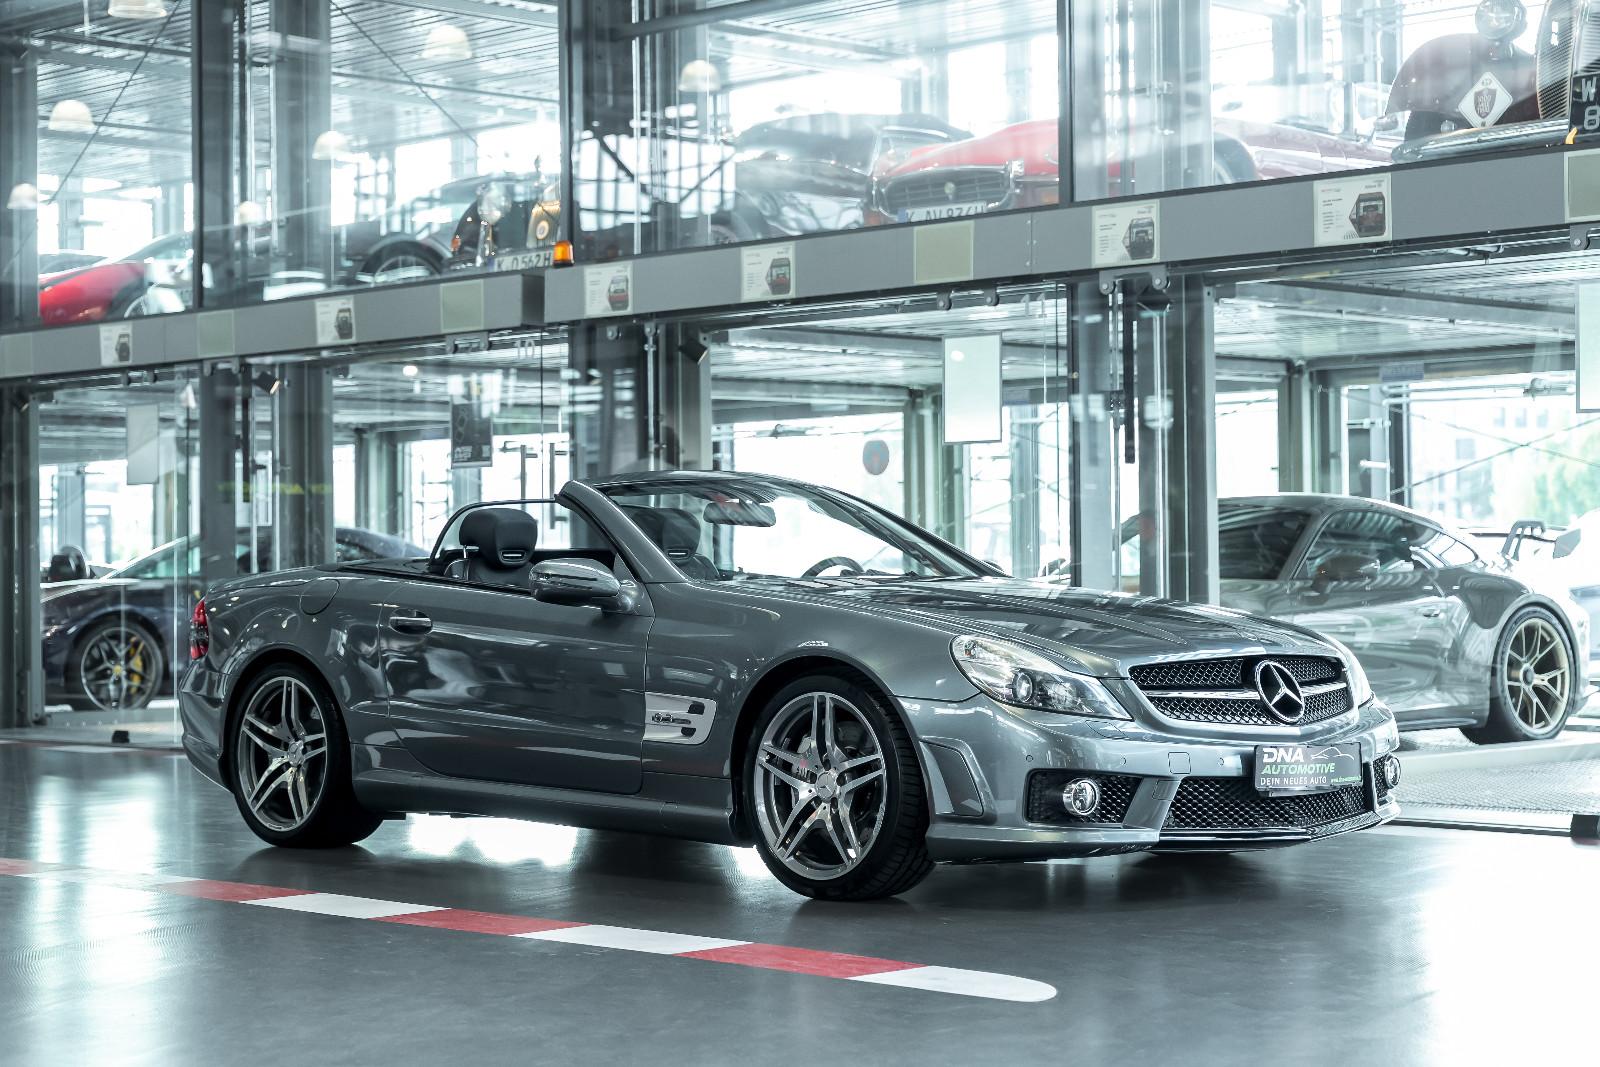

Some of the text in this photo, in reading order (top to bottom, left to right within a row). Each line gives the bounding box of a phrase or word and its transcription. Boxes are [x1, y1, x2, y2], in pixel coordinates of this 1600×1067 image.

[1581, 77, 1597, 101] W
[1583, 105, 1600, 130] 8
[1262, 747, 1304, 762] DNA
[1261, 763, 1335, 774] AUTOMOTIVE
[1260, 777, 1280, 786] DEIN
[1283, 776, 1308, 785] NEUES
[1309, 776, 1327, 785] AUTO
